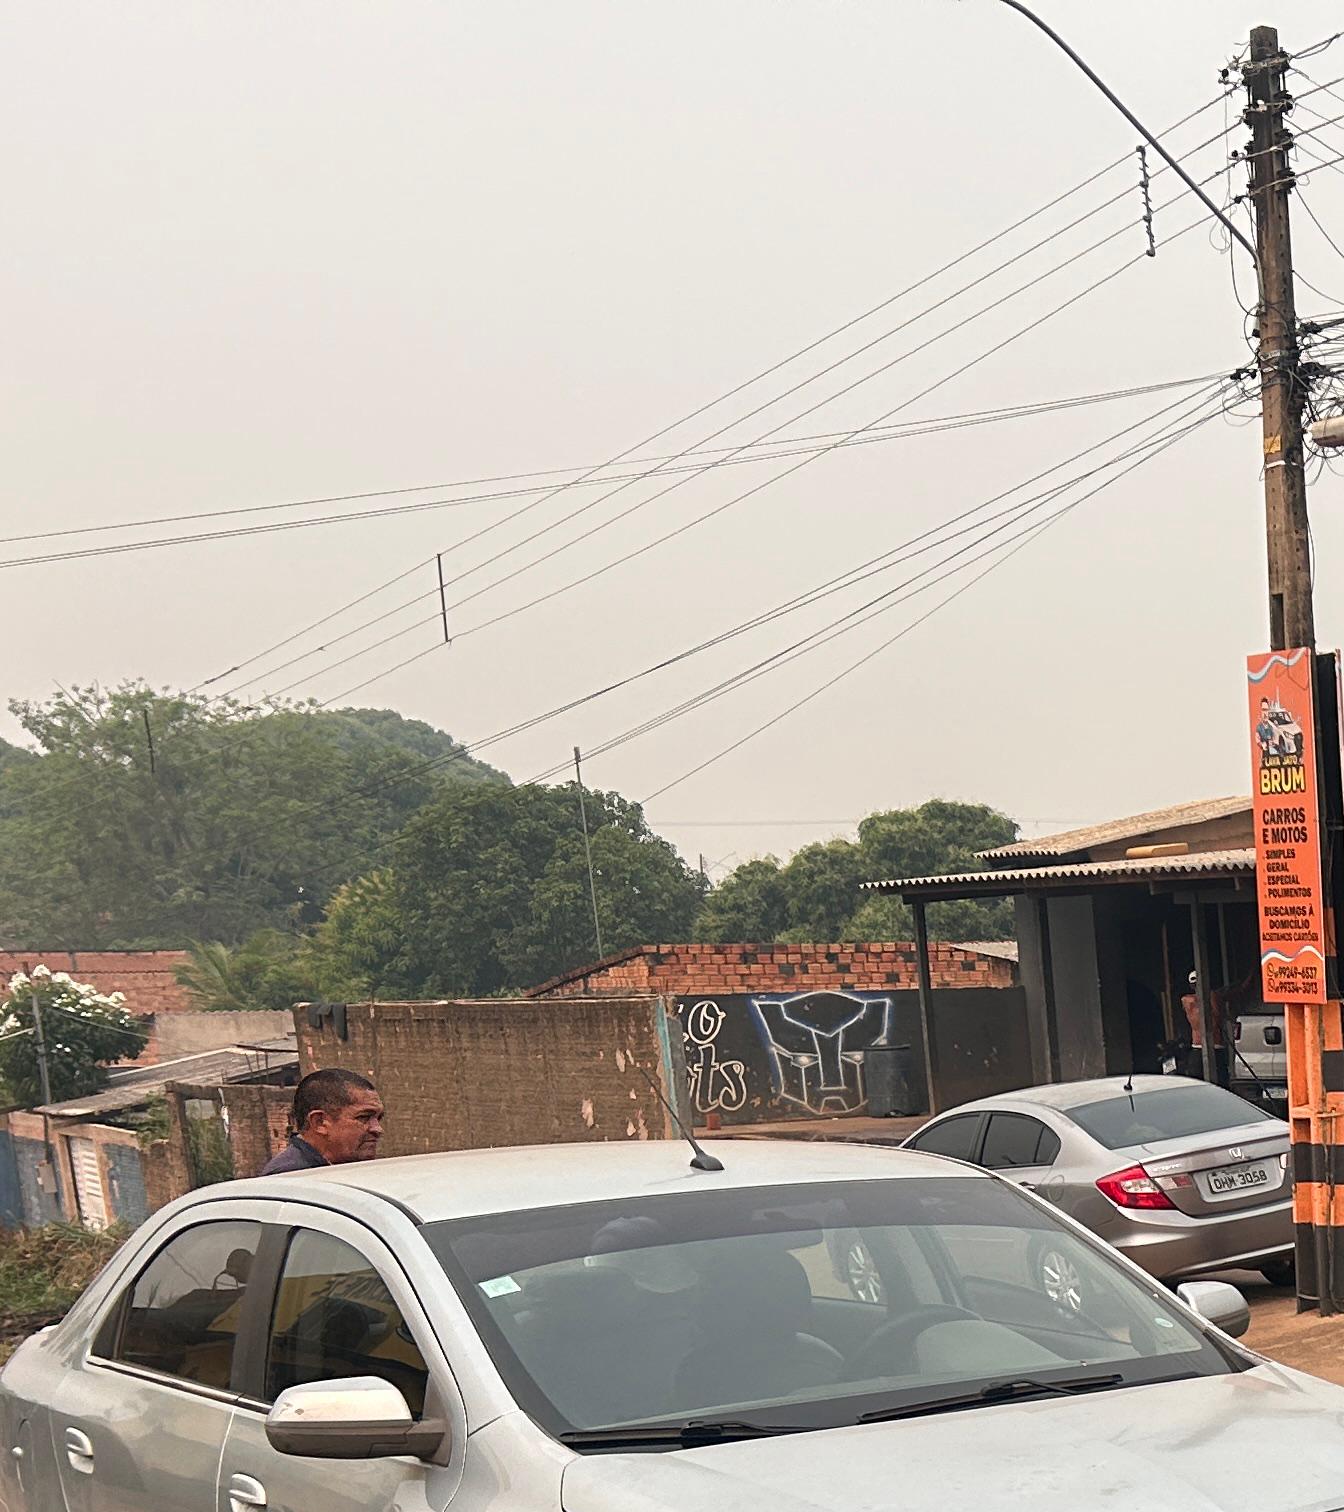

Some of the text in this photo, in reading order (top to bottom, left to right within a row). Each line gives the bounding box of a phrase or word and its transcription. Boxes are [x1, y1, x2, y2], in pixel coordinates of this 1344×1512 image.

[1260, 766, 1305, 794] BRUM
[1262, 807, 1305, 824] CARROS
[1262, 826, 1307, 844] E MOTOS
[1265, 848, 1295, 859] SIMPLES
[1266, 862, 1289, 871] GERAL
[1267, 874, 1299, 884] ESPECIAL
[1267, 887, 1311, 897] POLIMENTOS
[1264, 905, 1306, 916] BUSCAMOS
